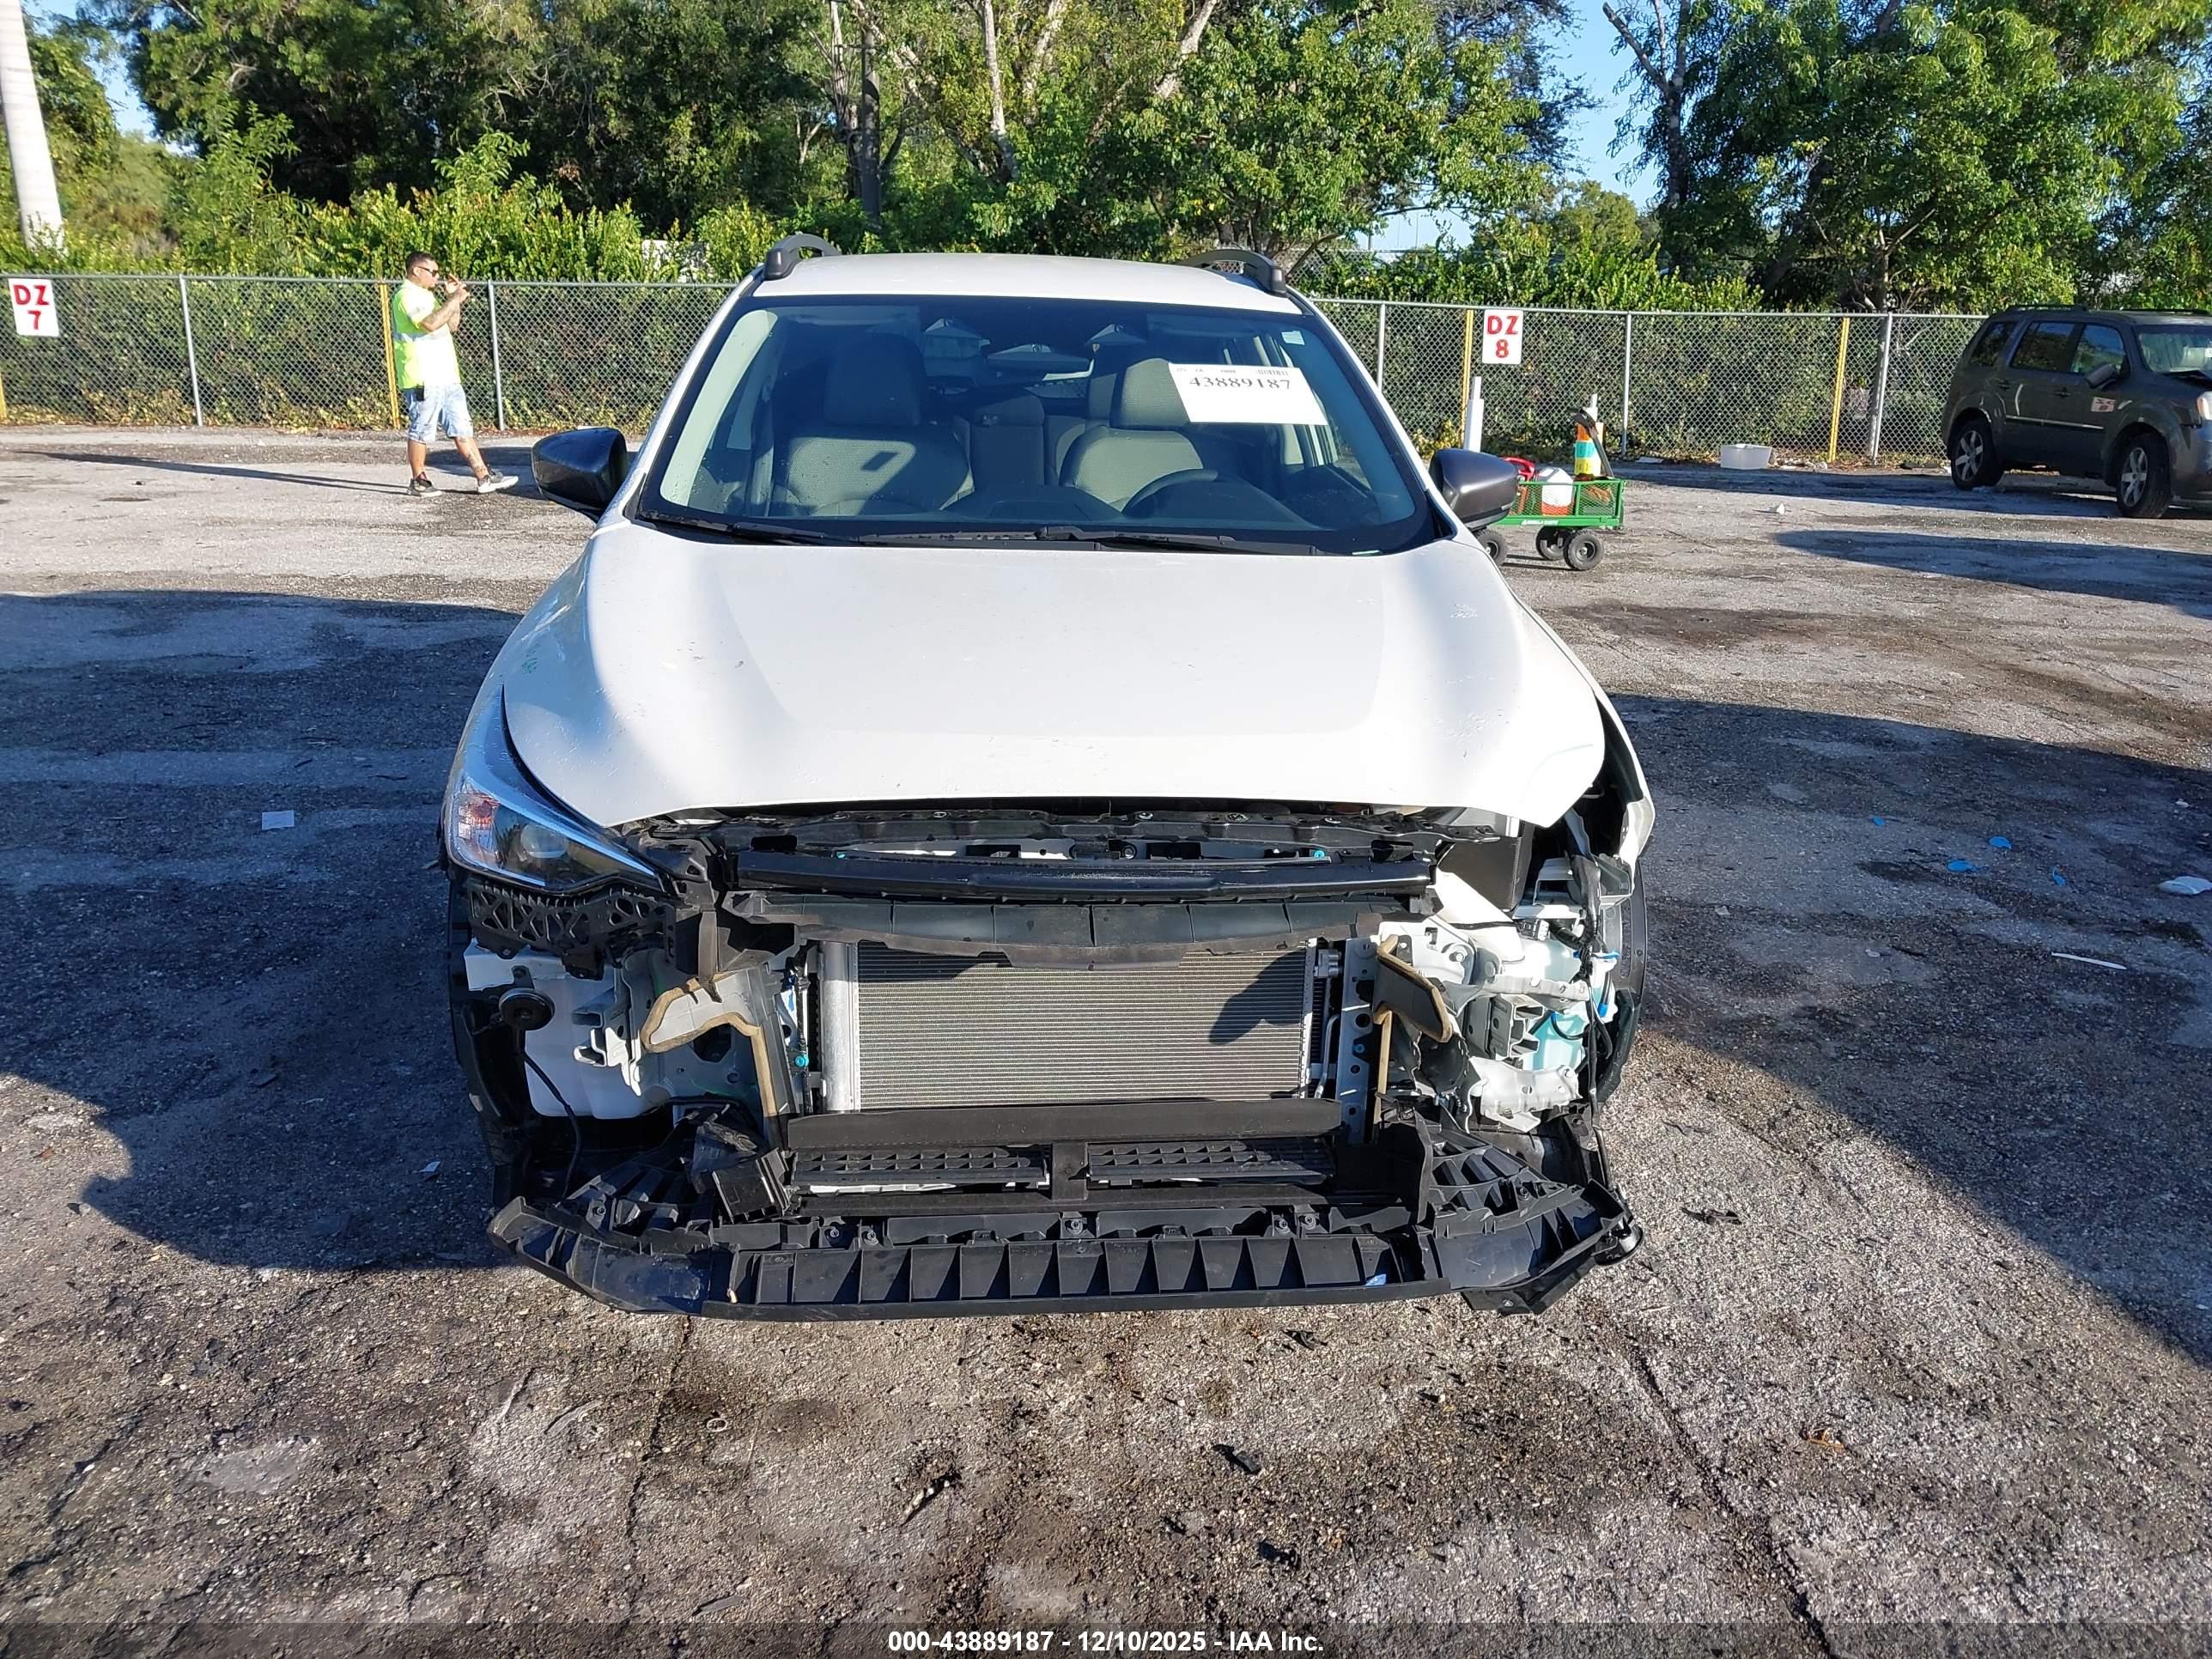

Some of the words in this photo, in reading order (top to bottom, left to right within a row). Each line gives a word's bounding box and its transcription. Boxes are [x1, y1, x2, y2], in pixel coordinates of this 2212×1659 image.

[13, 284, 50, 305] DZ
[27, 309, 41, 330] 7
[1487, 315, 1519, 335] DZ
[1496, 339, 1509, 358] 8
[1189, 376, 1291, 389] 43889187
